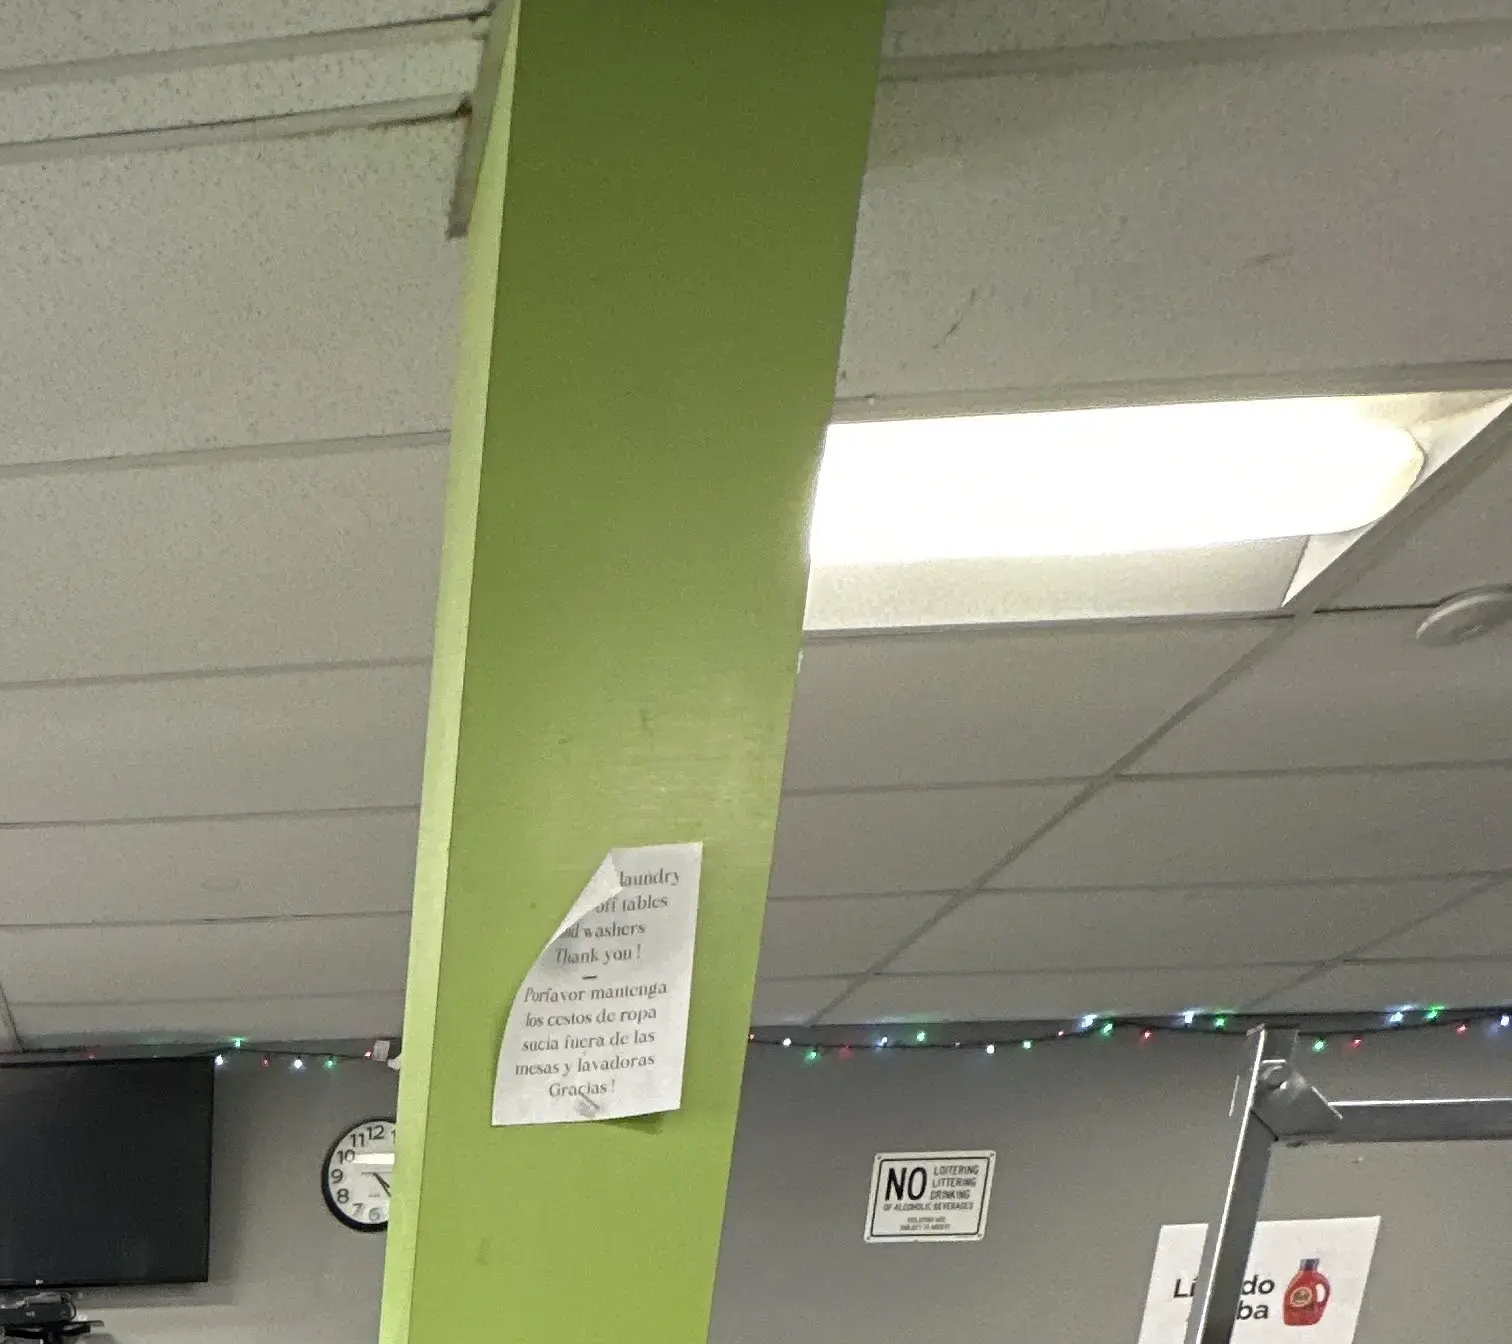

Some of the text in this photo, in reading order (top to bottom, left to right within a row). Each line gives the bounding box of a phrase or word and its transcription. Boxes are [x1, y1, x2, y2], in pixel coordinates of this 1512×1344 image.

[619, 868, 680, 888] laundry
[595, 894, 668, 914] off tables
[583, 923, 647, 939] washers
[555, 947, 632, 966] Thank you
[524, 981, 668, 1003] Porfavor mantenga
[525, 1008, 657, 1027] los cestos de ropa
[523, 1029, 655, 1051] sucia fuera de las
[515, 1054, 655, 1077] mesas y lavadoras
[549, 1082, 607, 1097] Gracias
[350, 1133, 365, 1147] 11
[367, 1125, 384, 1140] 12
[337, 1149, 356, 1165] 10
[331, 1168, 343, 1184] 9
[934, 1165, 979, 1176] LOITERING
[885, 1166, 928, 1201] NO
[932, 1178, 977, 1188] LITTERING
[337, 1188, 349, 1204] 8
[930, 1190, 971, 1200] DRINKING
[352, 1202, 363, 1218] 7
[368, 1207, 381, 1221] 6
